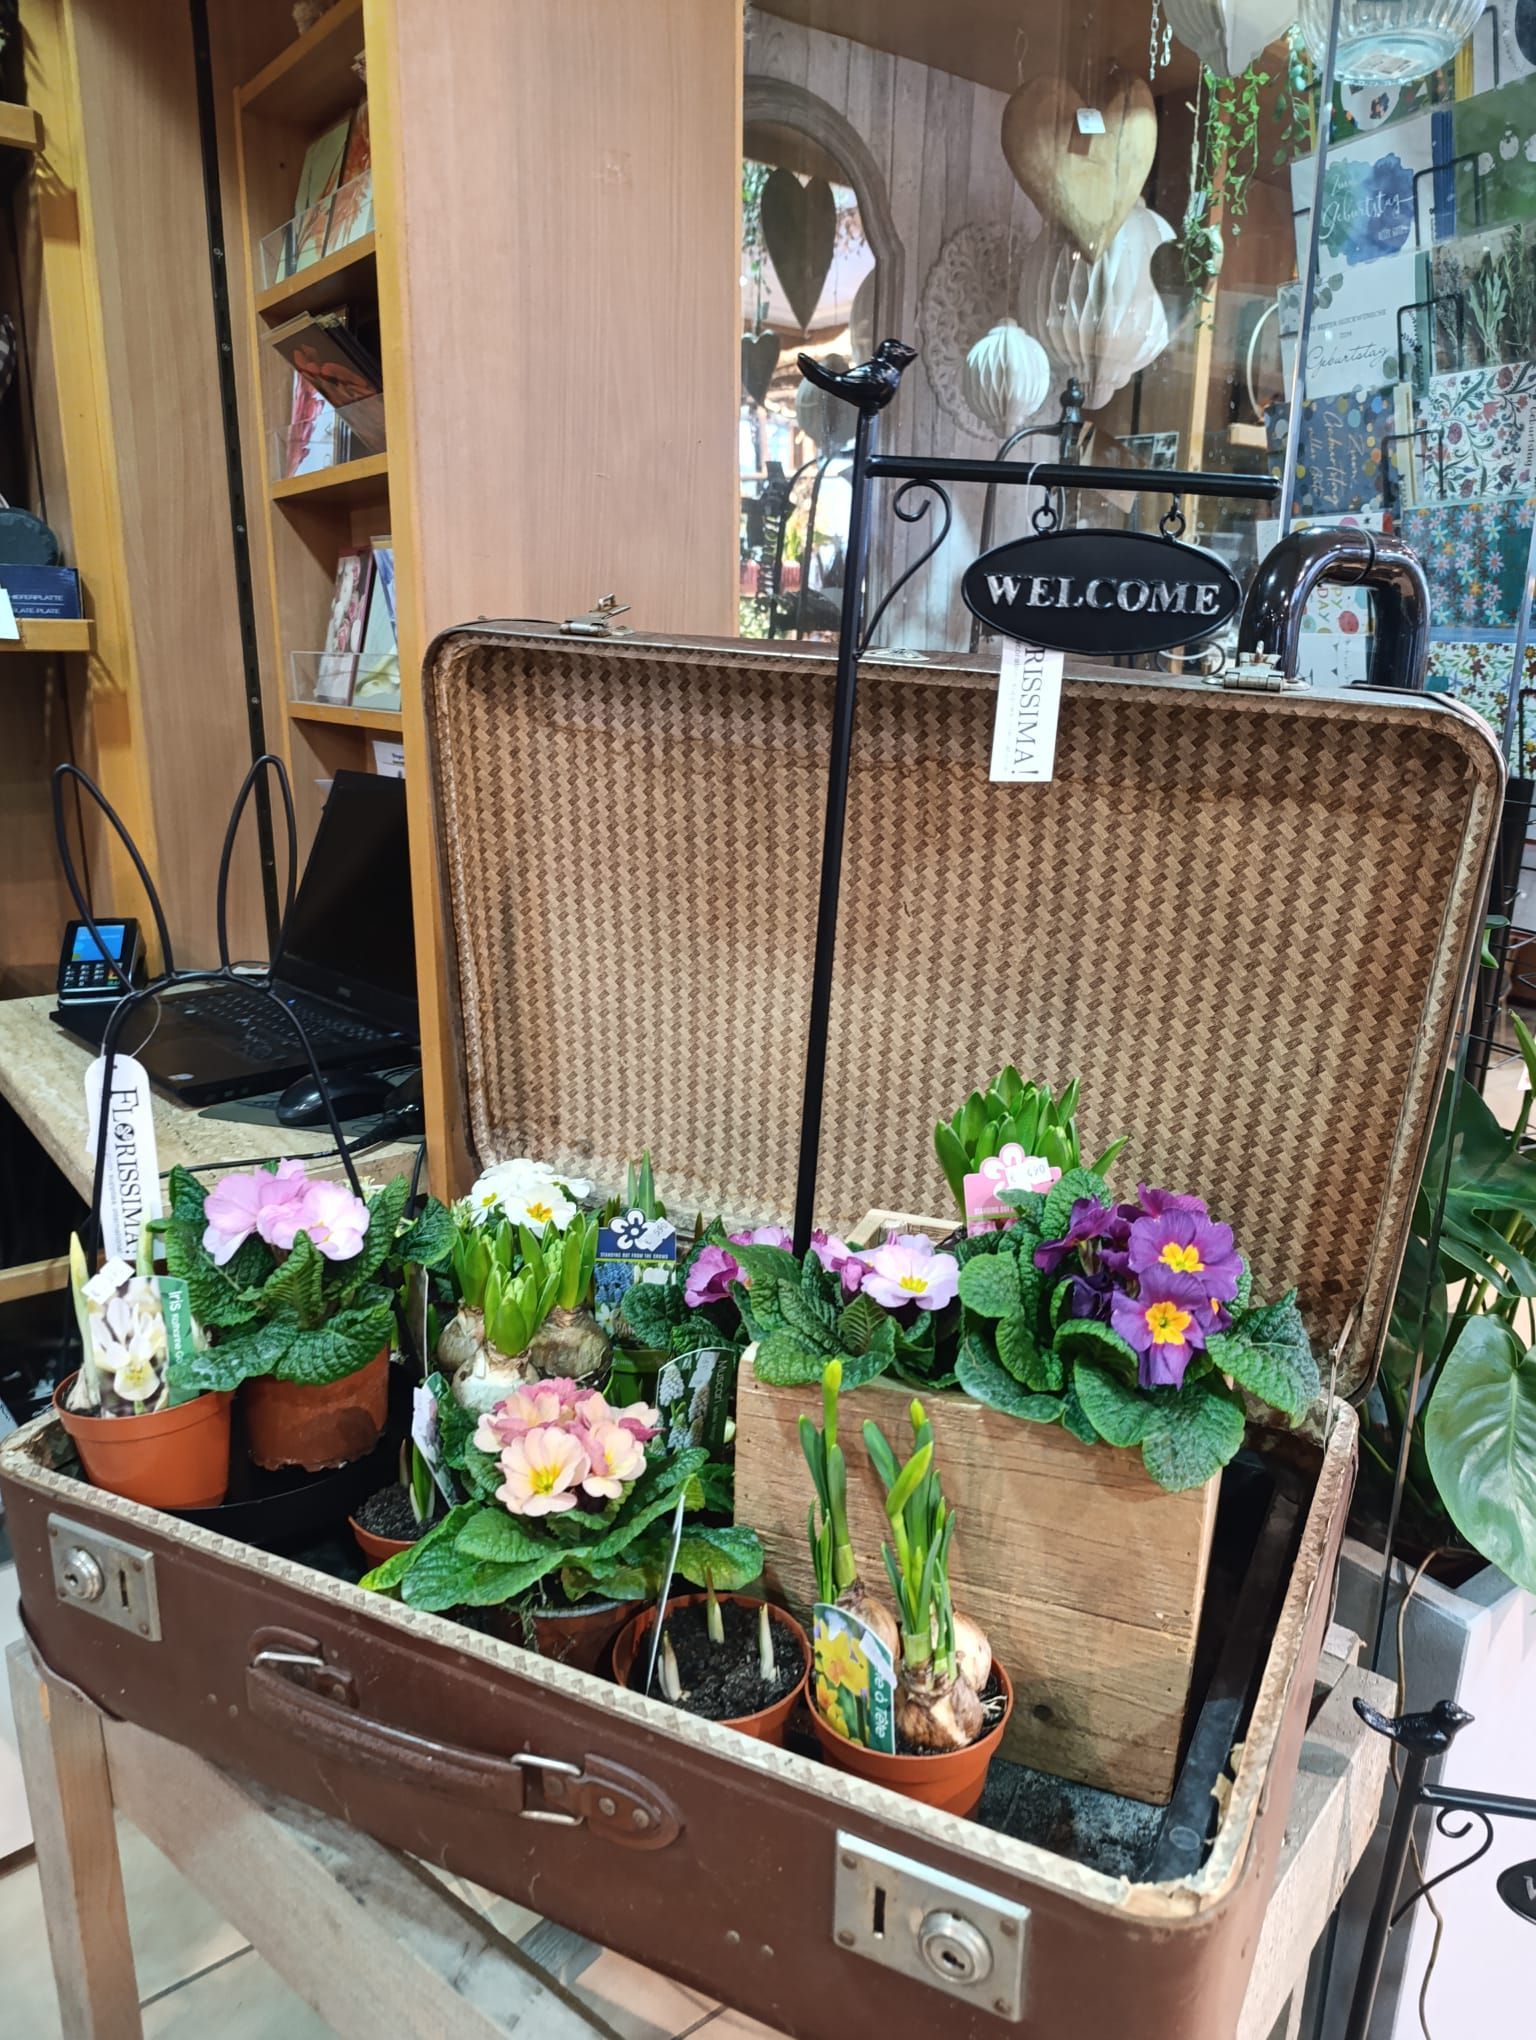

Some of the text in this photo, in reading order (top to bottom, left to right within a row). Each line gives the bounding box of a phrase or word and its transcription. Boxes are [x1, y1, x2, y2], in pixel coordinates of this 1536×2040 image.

[1319, 189, 1414, 240] Geburtstag
[984, 573, 1220, 616] WELCOME
[1317, 587, 1331, 623] DAY
[1011, 645, 1046, 775] RISSIMA!
[168, 1290, 184, 1312] Iris
[713, 1360, 729, 1405] Muscari
[875, 1706, 890, 1739] Tête
